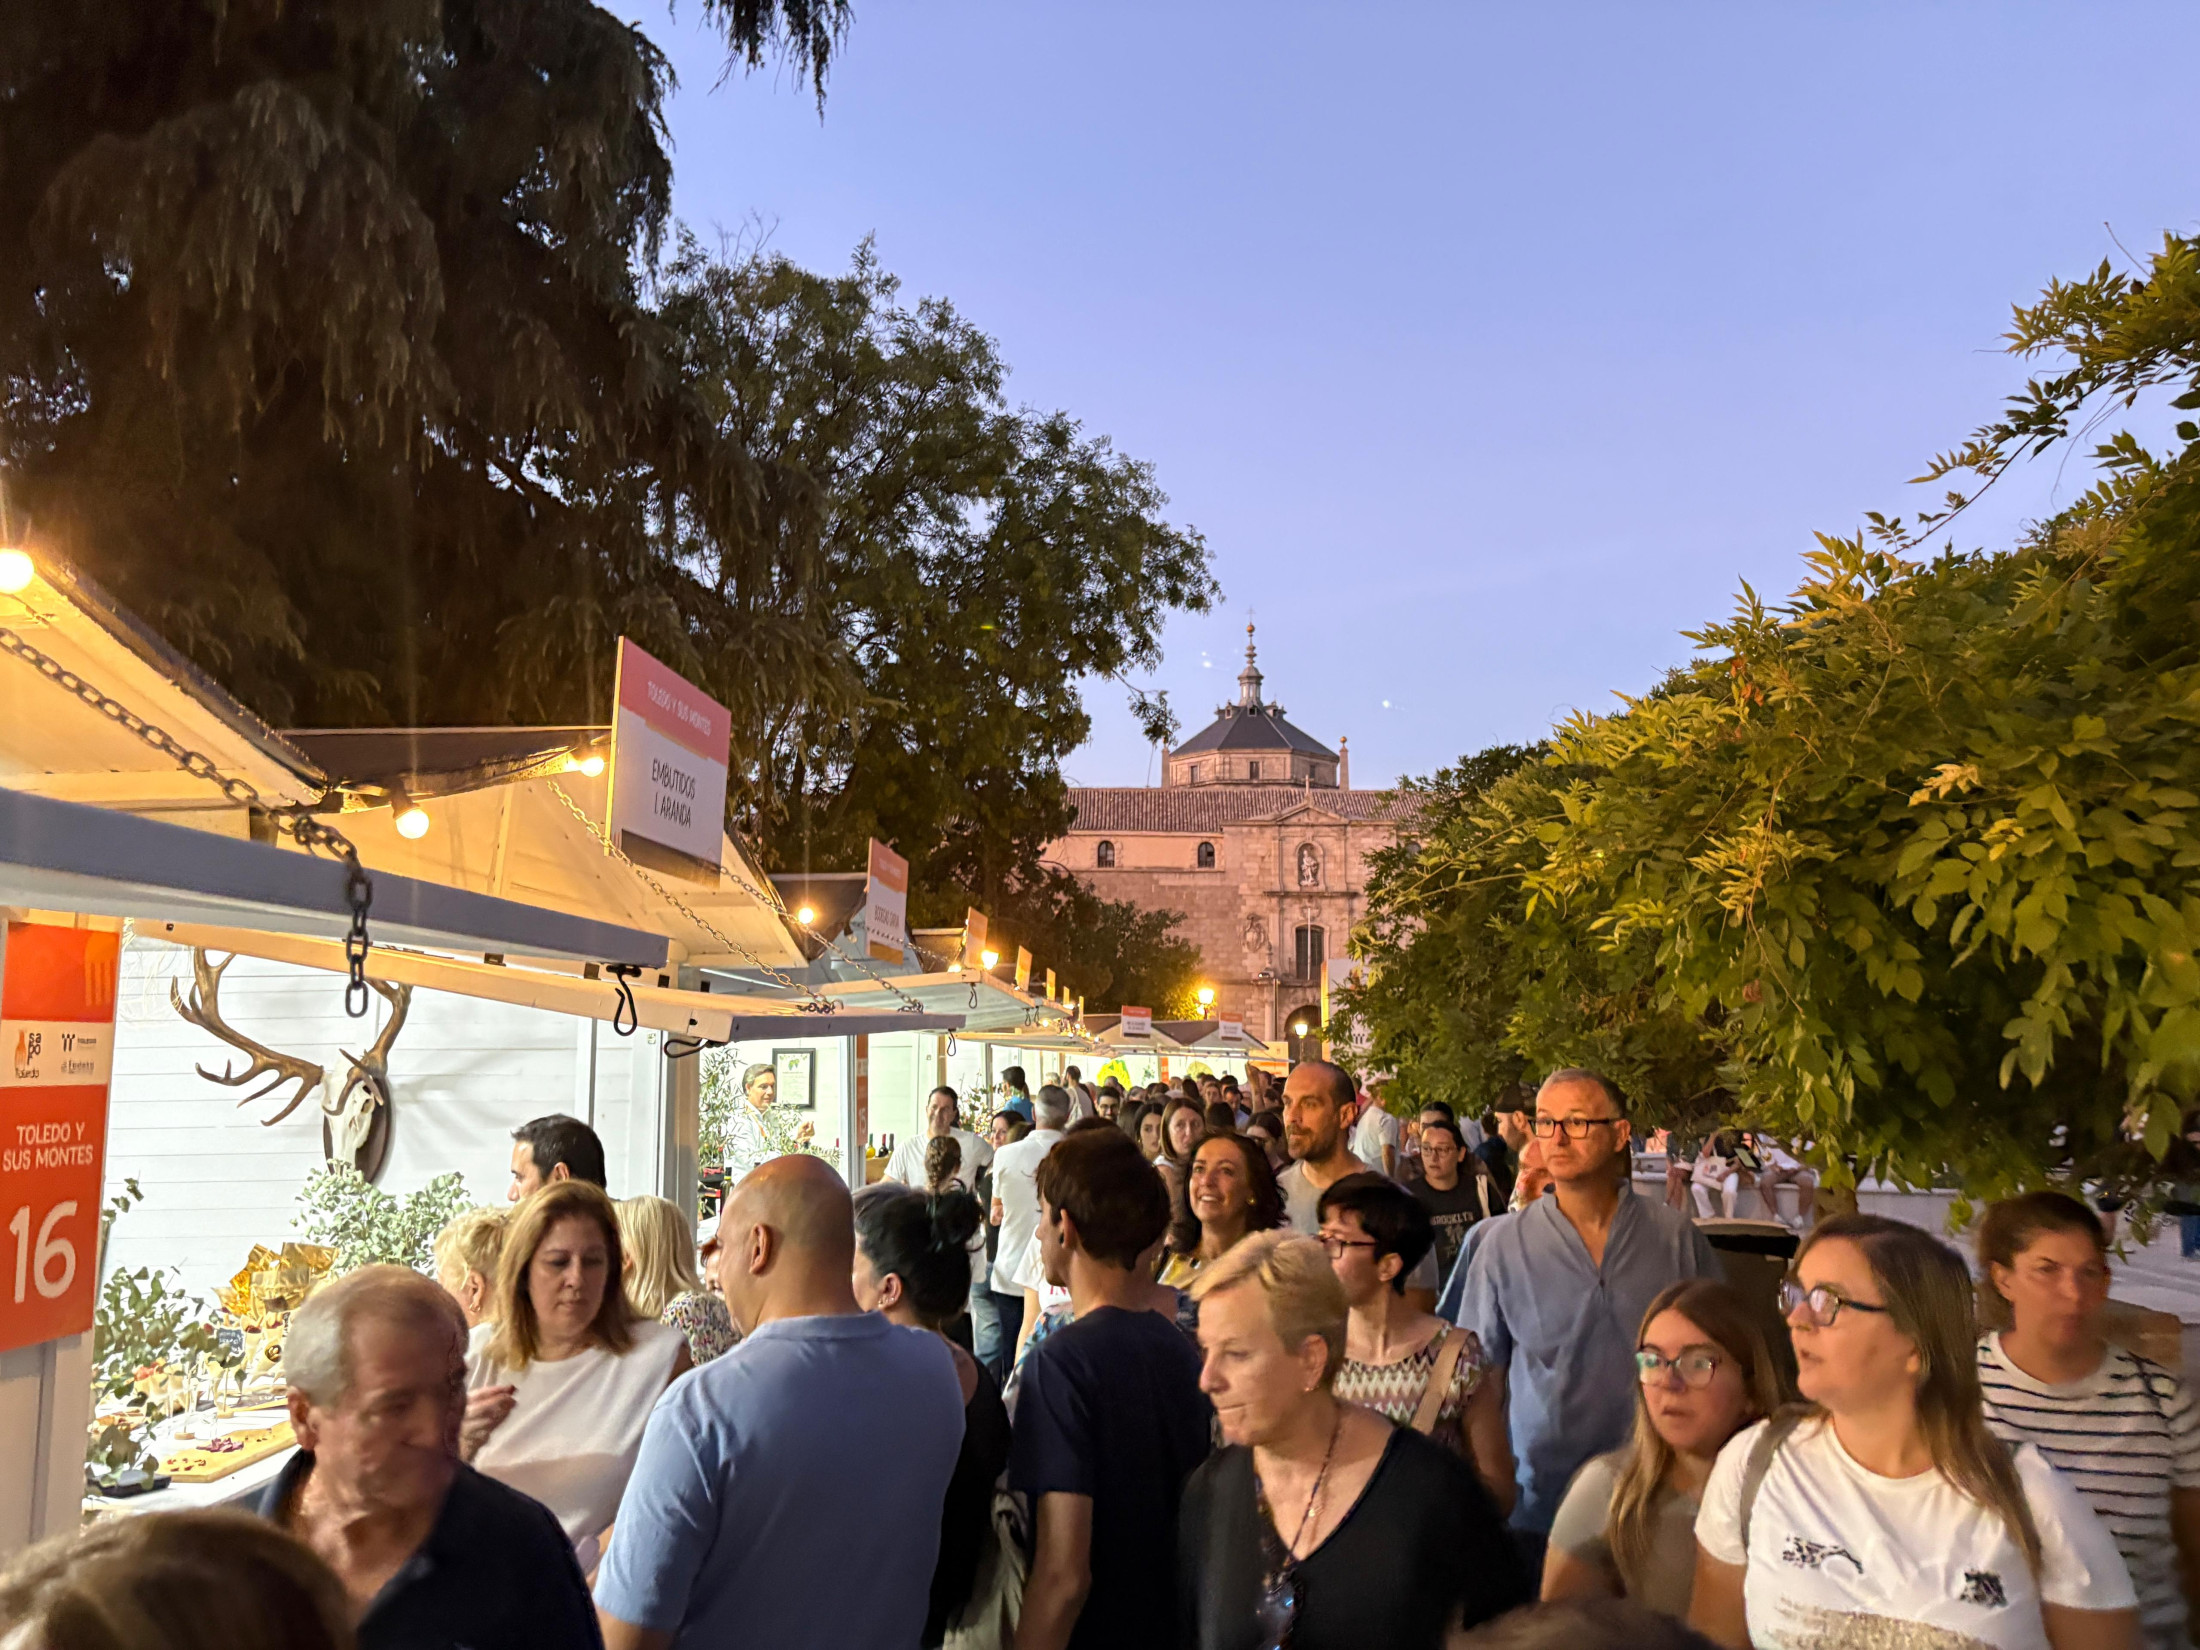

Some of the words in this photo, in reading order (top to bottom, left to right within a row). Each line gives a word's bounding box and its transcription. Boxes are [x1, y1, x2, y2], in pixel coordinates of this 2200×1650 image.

[652, 758, 696, 800] EMBUTIDOS
[660, 795, 691, 828] ARANDA
[16, 1122, 71, 1146] TOLEDO
[75, 1121, 86, 1142] Y
[3, 1148, 31, 1172] SUS
[35, 1144, 94, 1169] MONTES
[9, 1200, 78, 1304] 16
